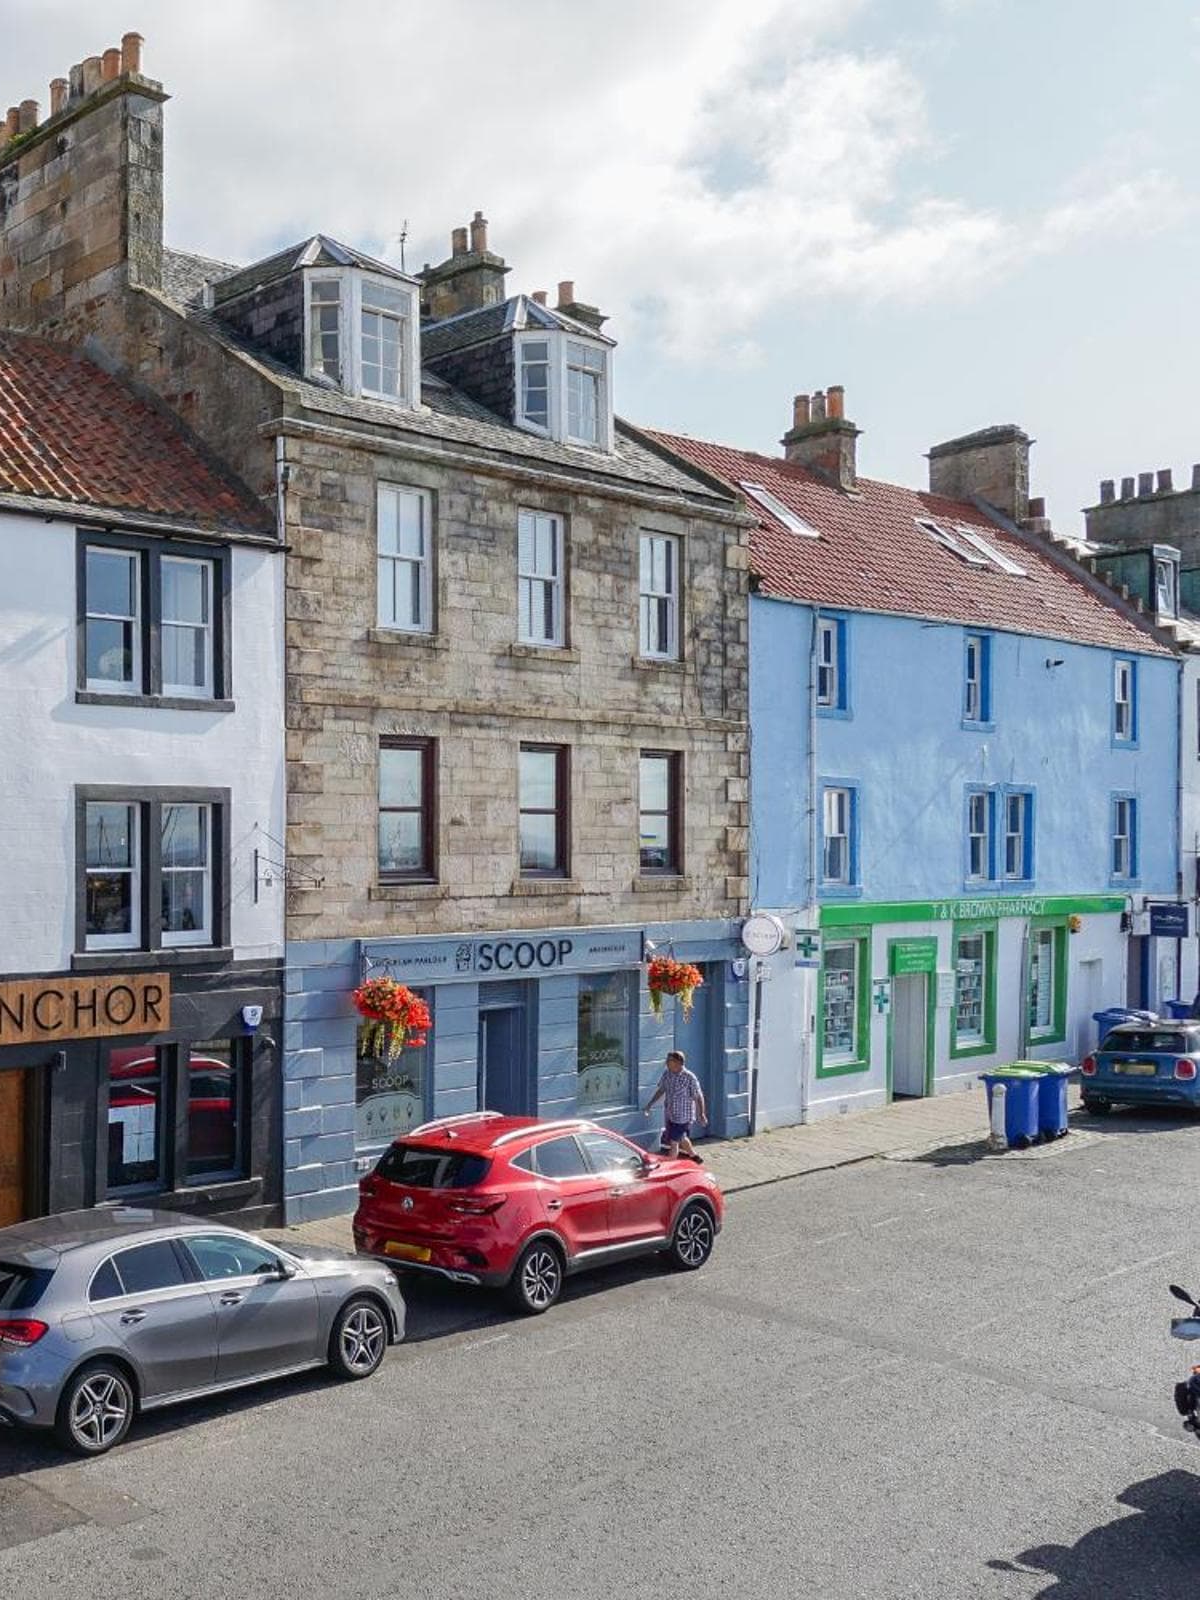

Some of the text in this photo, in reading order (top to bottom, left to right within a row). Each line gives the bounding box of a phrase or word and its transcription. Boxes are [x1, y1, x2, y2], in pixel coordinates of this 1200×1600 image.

[960, 901, 997, 918] BROWN
[998, 899, 1047, 917] PHARMACY
[479, 940, 573, 971] SCOOP
[372, 1075, 409, 1089] SCOOP
